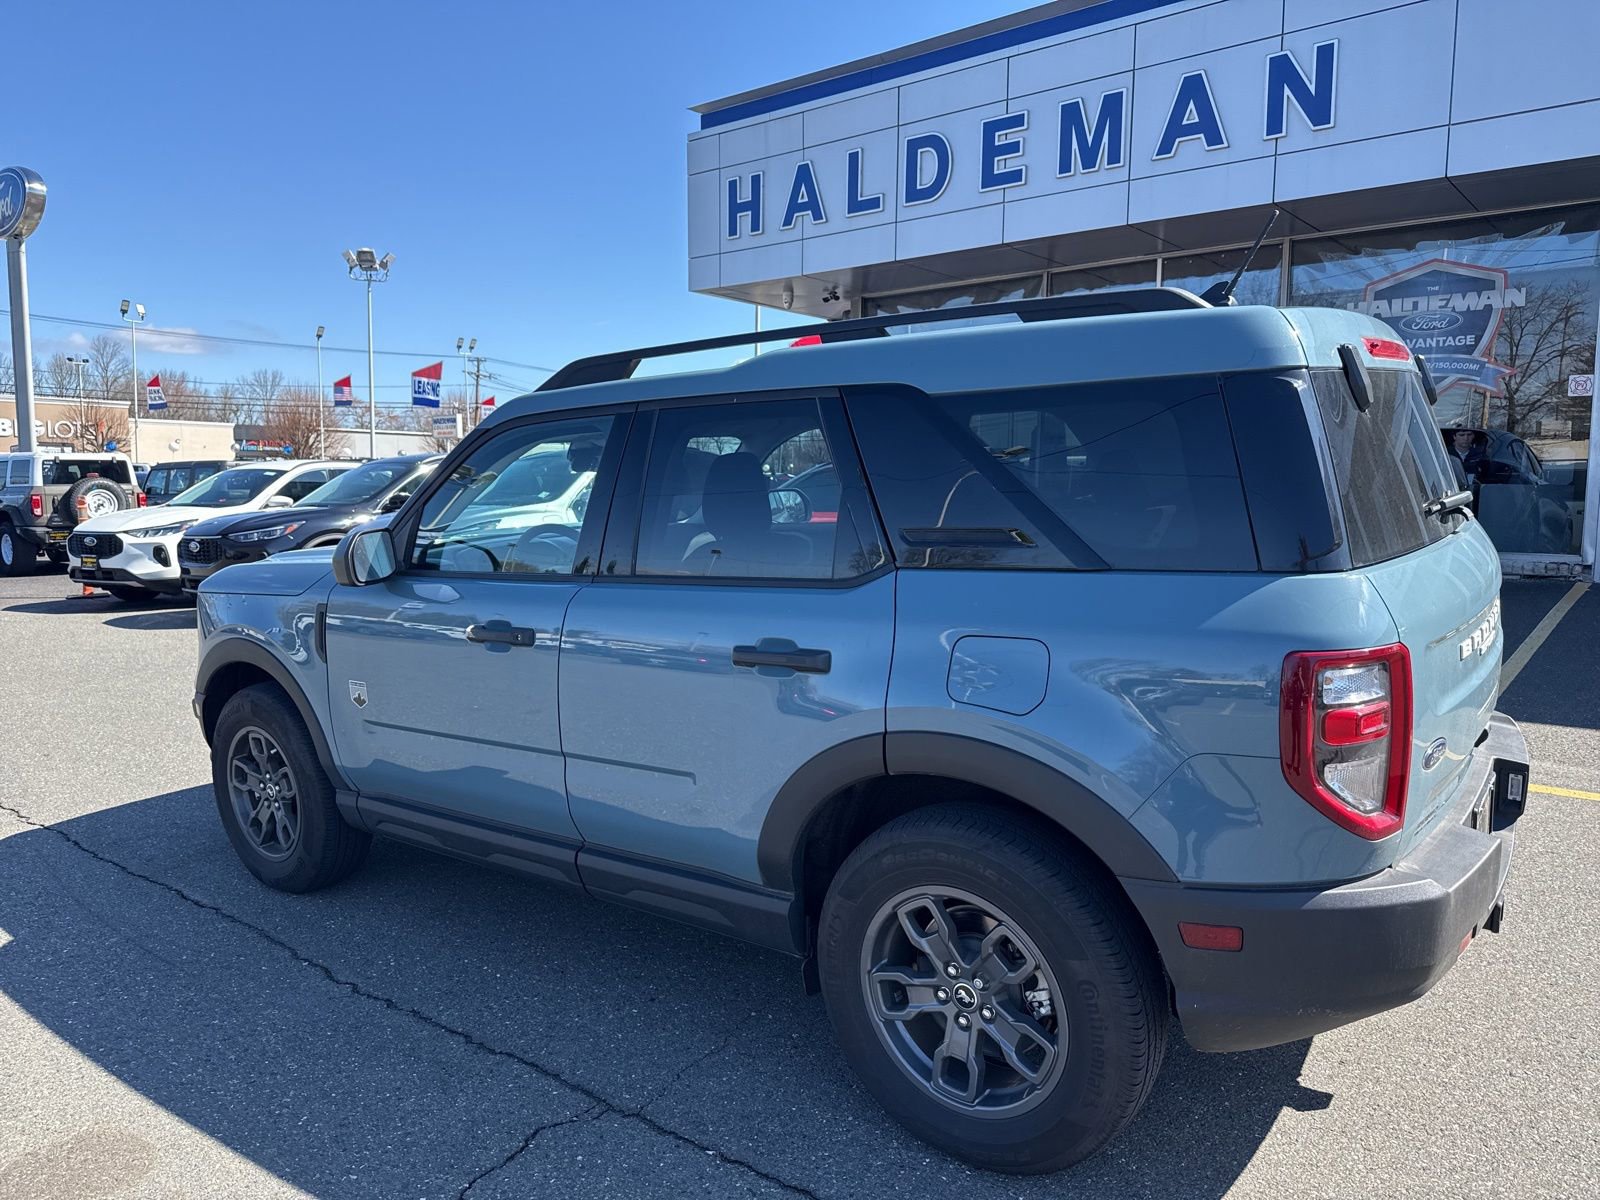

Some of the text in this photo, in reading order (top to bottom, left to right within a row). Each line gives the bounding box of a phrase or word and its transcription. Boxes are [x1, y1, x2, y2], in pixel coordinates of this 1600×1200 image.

[726, 38, 1340, 240] HALDEMAN
[1347, 287, 1527, 319] HALDEMAN
[1411, 314, 1450, 330] Ford
[1406, 334, 1476, 349] VANTAGE
[413, 380, 440, 397] LEASING
[1459, 597, 1500, 661] BRONC
